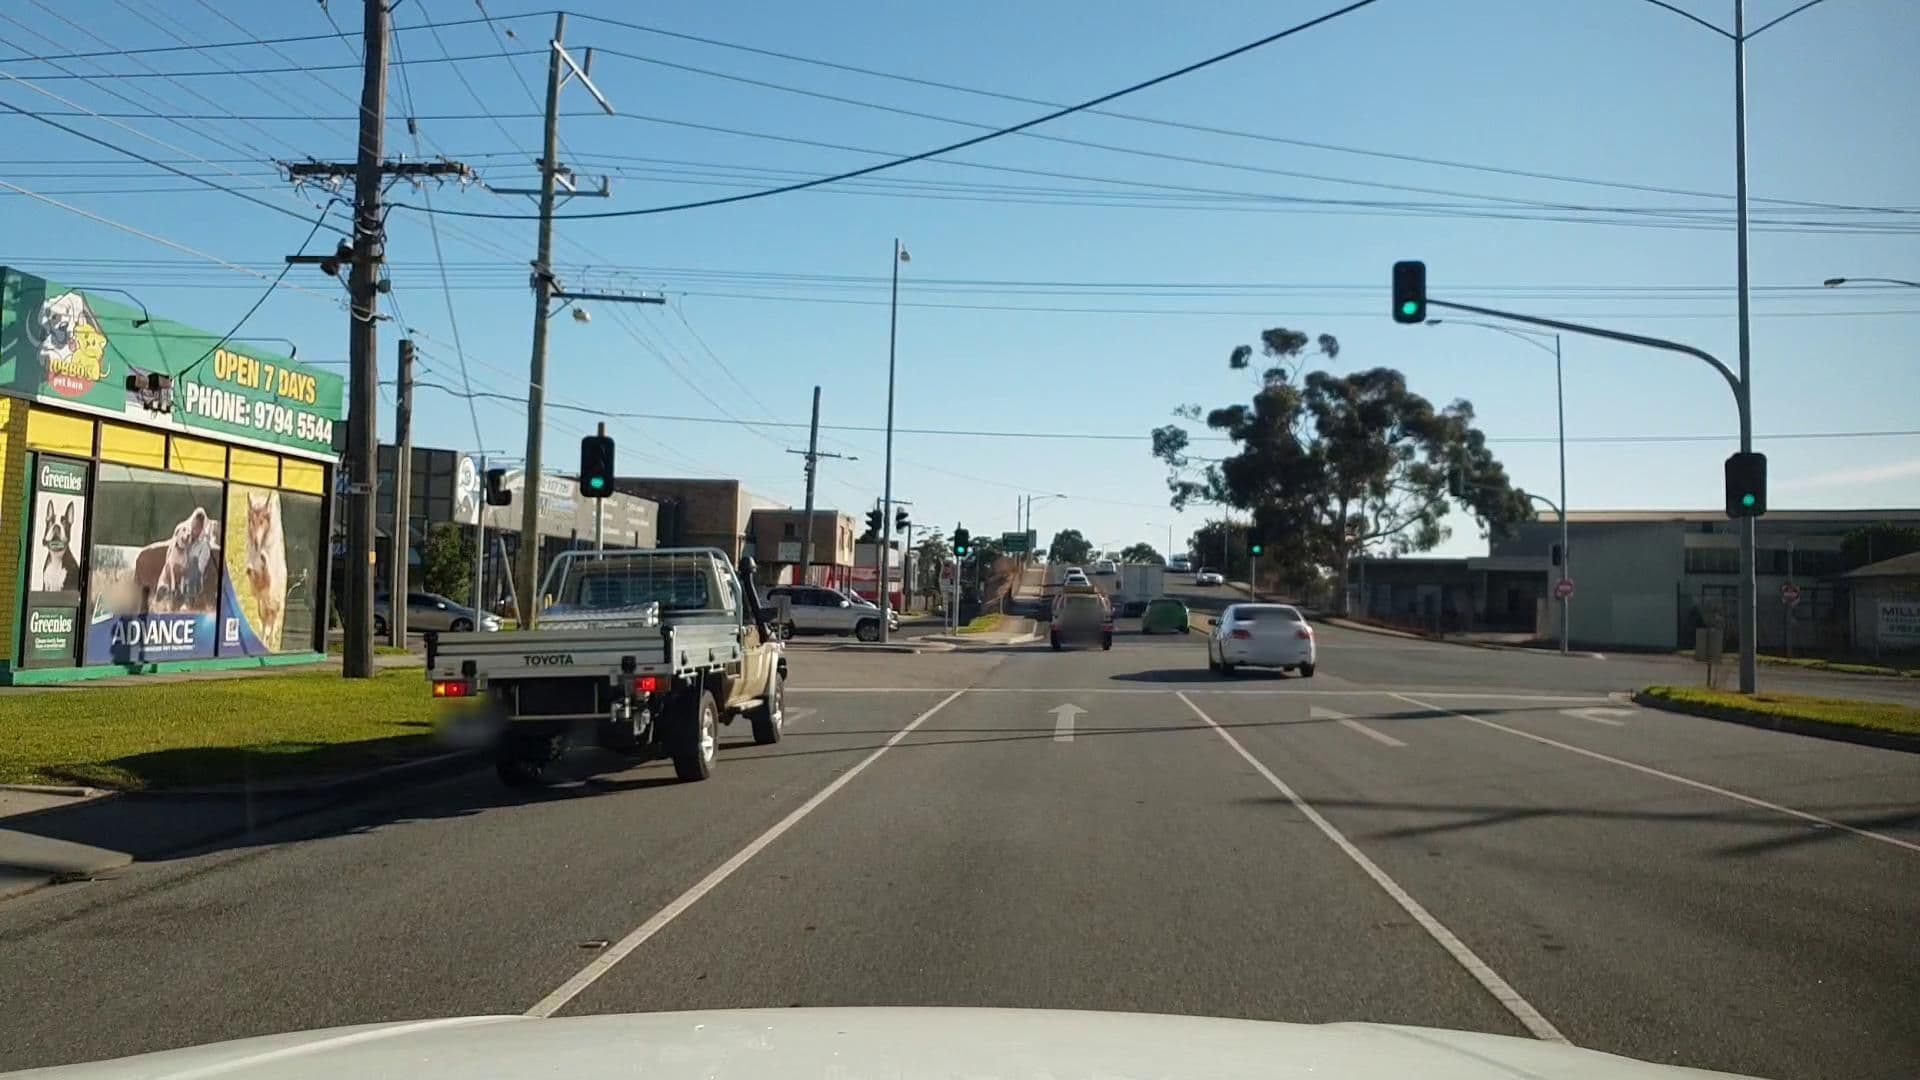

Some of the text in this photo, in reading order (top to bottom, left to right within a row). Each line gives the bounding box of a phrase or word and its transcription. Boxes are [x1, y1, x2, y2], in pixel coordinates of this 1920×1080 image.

[214, 349, 316, 404] OPEN 7 DAYS
[186, 381, 333, 445] PHONE: 9794 5544
[41, 465, 82, 491] Greenies
[30, 611, 72, 633] Greenies
[111, 620, 195, 645] ADVANCE
[524, 655, 574, 665] TOYOTA
